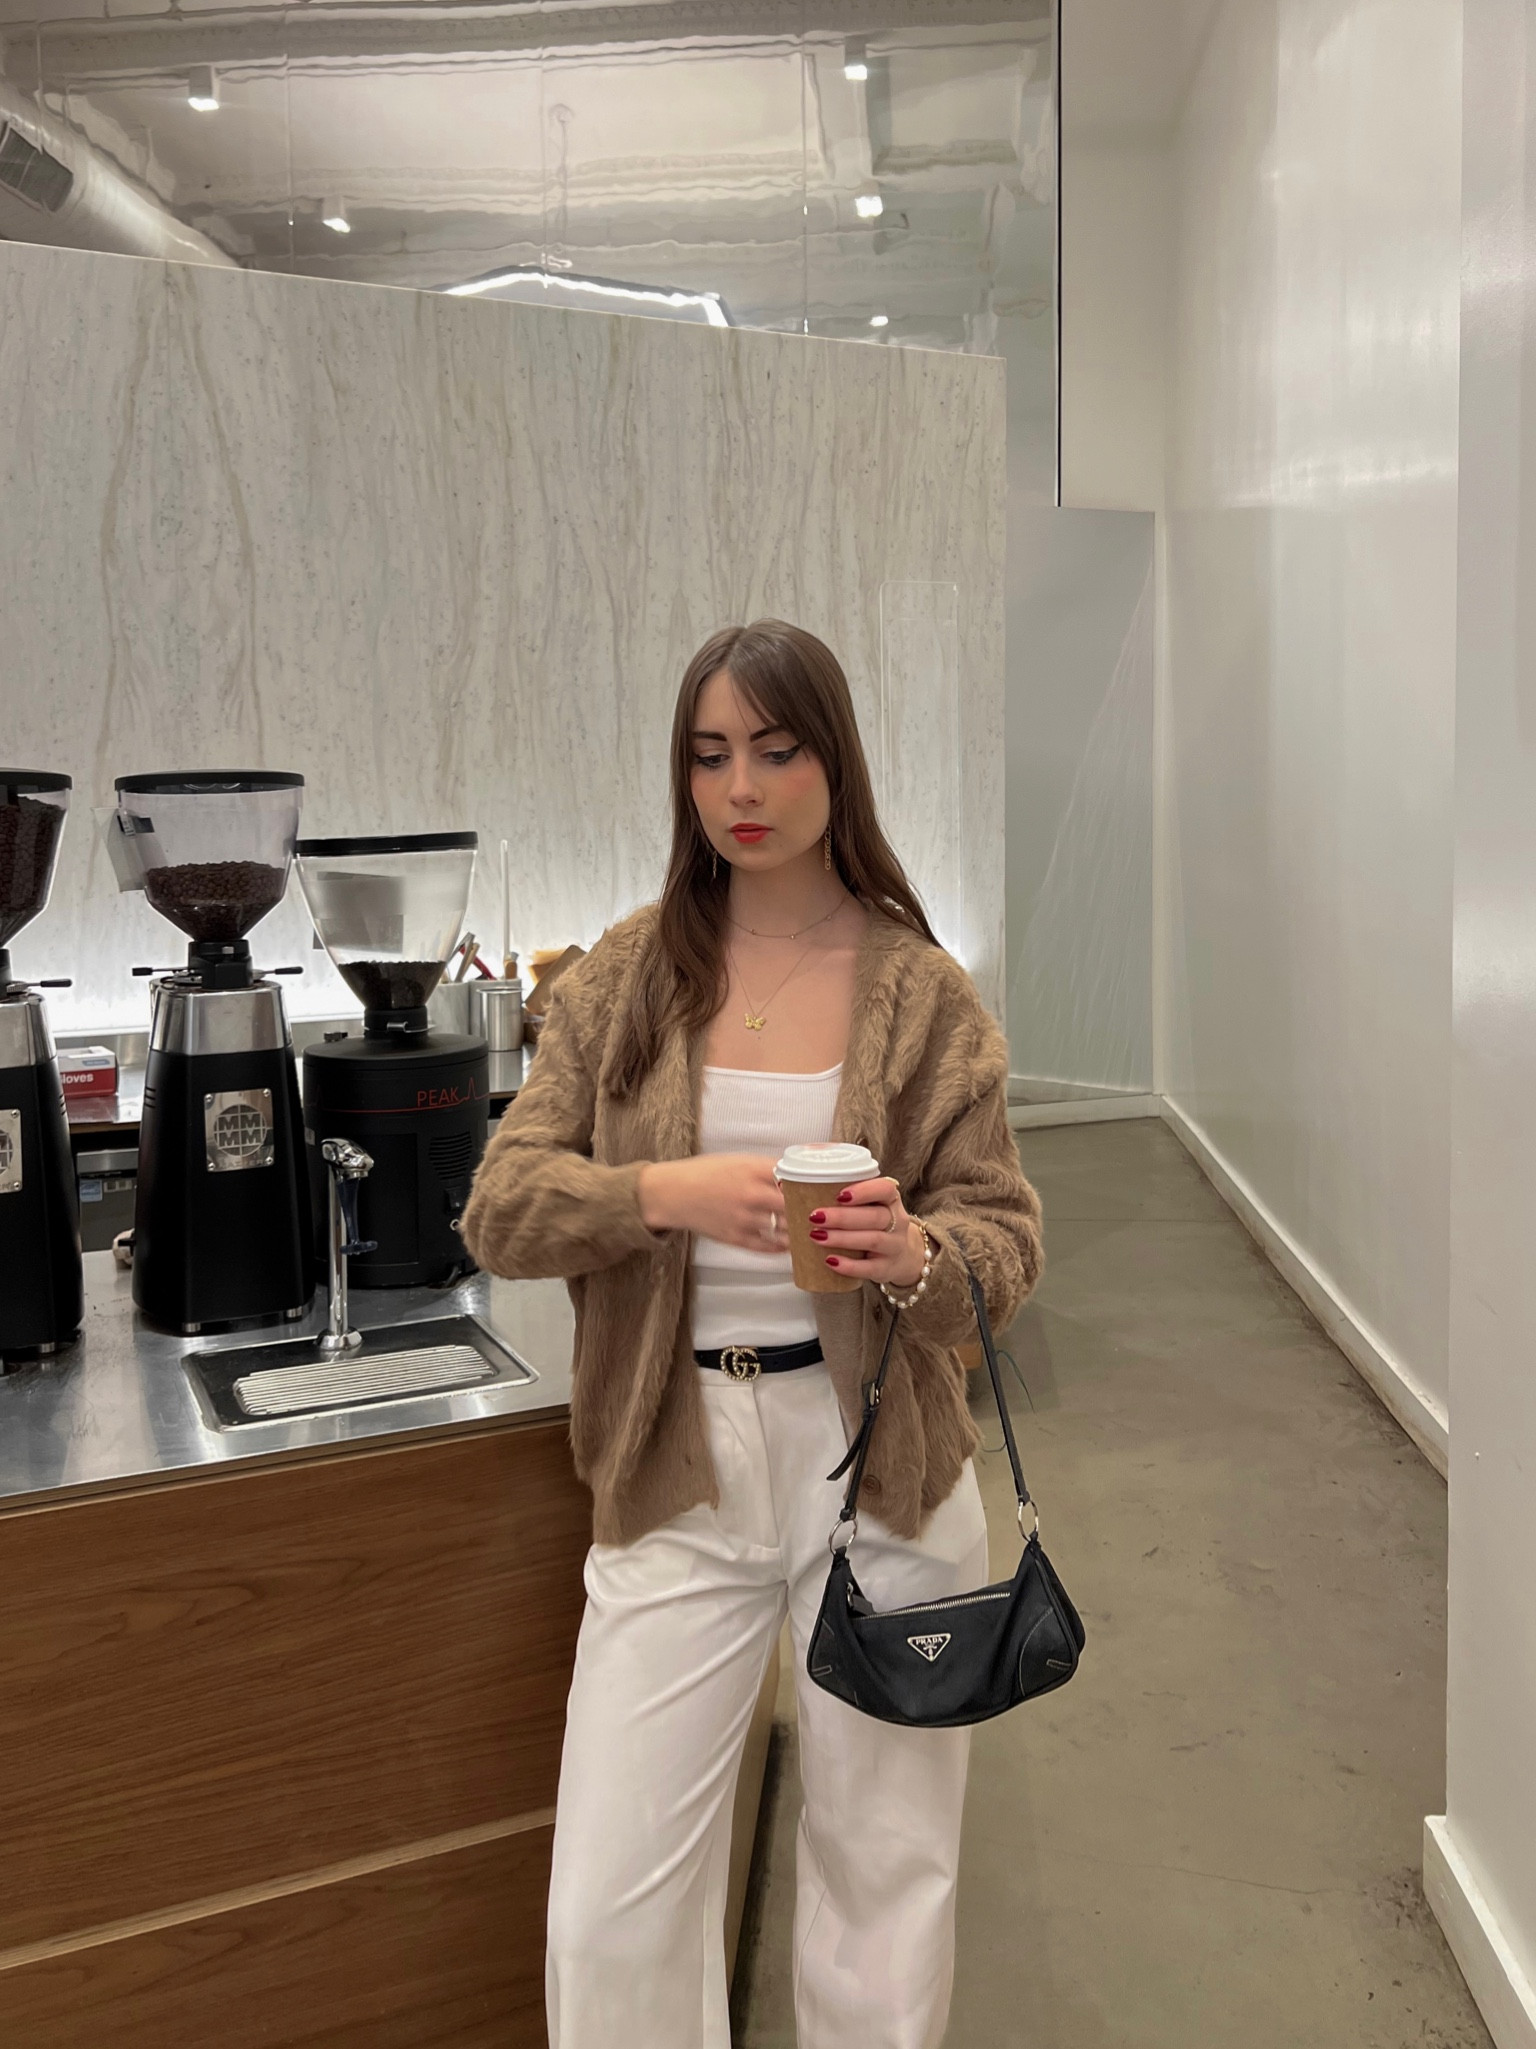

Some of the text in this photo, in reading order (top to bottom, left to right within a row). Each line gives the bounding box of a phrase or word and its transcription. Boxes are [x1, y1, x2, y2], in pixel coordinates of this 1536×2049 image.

[61, 1073, 94, 1084] loves
[417, 1086, 459, 1107] PEAK
[916, 1636, 943, 1645] PRADA
